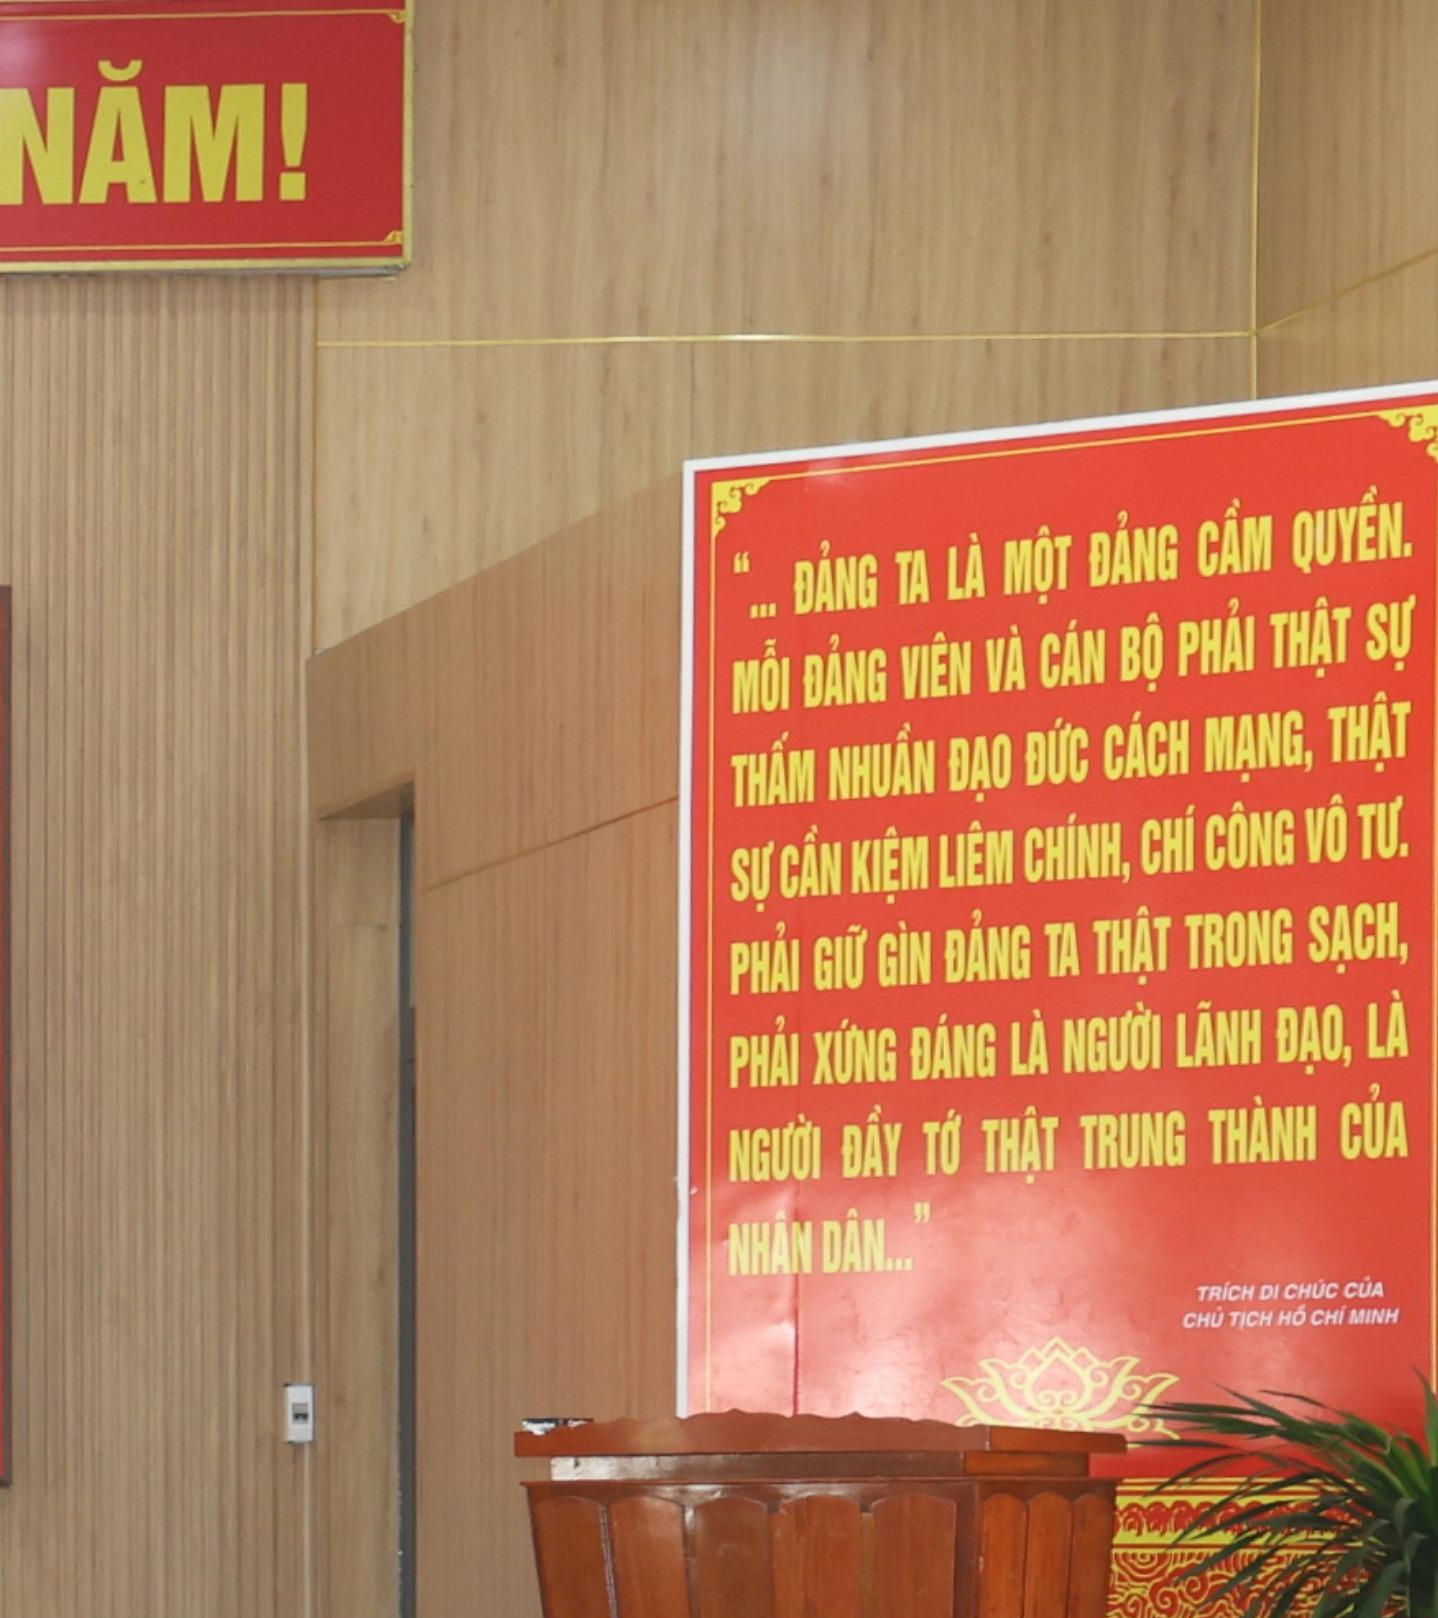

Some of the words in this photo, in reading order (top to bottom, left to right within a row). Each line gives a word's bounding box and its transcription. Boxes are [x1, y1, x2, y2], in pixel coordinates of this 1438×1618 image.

[794, 541, 878, 615] ĐẢNG
[895, 549, 930, 605] TA
[947, 534, 986, 600] LÀ
[1004, 526, 1072, 603] MỘT
[1089, 512, 1178, 587] ĐẢNG
[1197, 501, 1273, 576] CẦM
[1292, 488, 1412, 573] QUYỀN.
[732, 640, 790, 713] MỖI
[803, 636, 887, 708] ĐẢNG
[900, 633, 972, 699] VIÊN
[986, 627, 1026, 693] VÀ
[1040, 621, 1106, 688] CÁN
[1120, 613, 1163, 692] BỘ
[1178, 598, 1255, 676] PHẢI
[1269, 597, 1352, 677] THẬT
[1365, 596, 1416, 671] SỰ
[730, 843, 775, 912] SỰ
[780, 827, 842, 898] CẦN
[851, 828, 929, 903] KIỆM
[939, 822, 1014, 888] LIÊM
[1024, 816, 1131, 883] CHÍNH,
[1141, 805, 1195, 875] CHÍ
[1205, 802, 1295, 870] CÔNG
[1305, 795, 1347, 863] VÔ
[1357, 797, 1409, 859] TƯ.
[728, 1213, 813, 1275] NHÂN
[1183, 1307, 1224, 1328] CHỦ
[1230, 1311, 1272, 1329] TỊCH
[1310, 1310, 1344, 1326] CHÍ
[1349, 1309, 1399, 1324] MINH
[1198, 1282, 1255, 1301] TRÍCH
[1259, 1285, 1279, 1300] DI
[1284, 1283, 1338, 1299] CHÚC
[1344, 1277, 1383, 1298] CỦA
